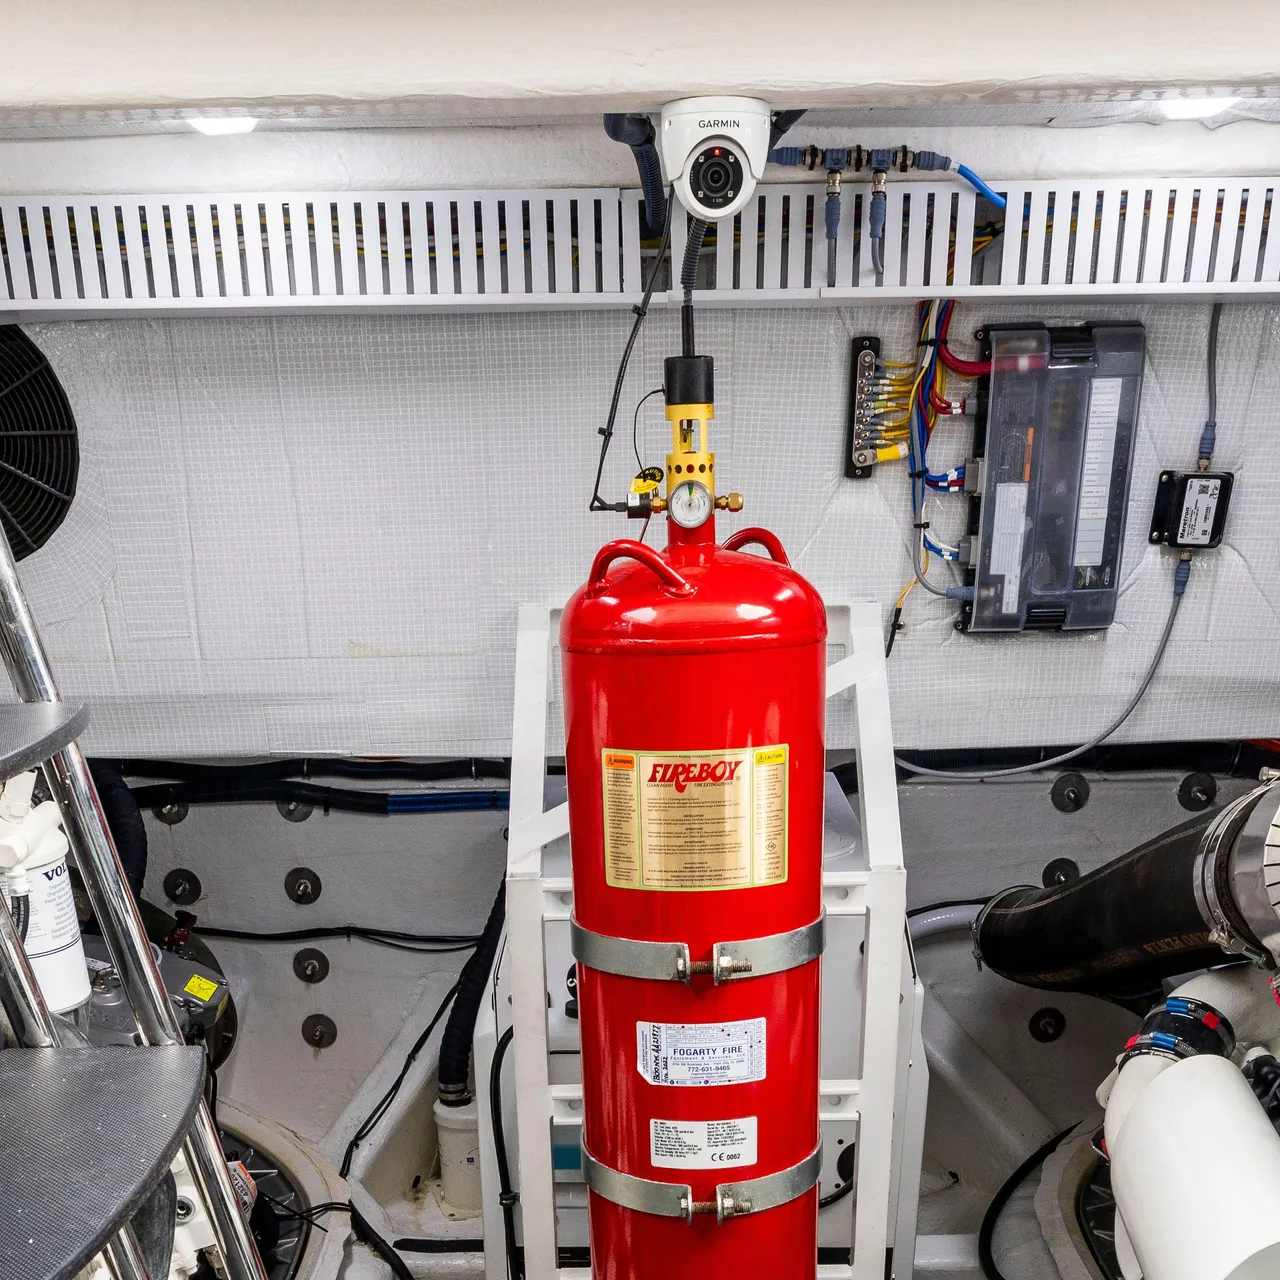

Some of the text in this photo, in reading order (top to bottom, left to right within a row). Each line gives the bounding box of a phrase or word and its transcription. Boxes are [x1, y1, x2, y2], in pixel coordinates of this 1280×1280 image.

[698, 120, 740, 128] GARMIN
[1178, 507, 1190, 540] Maretron
[647, 760, 744, 794] FIREBOY
[673, 1046, 743, 1056] FOGARTY FIRE
